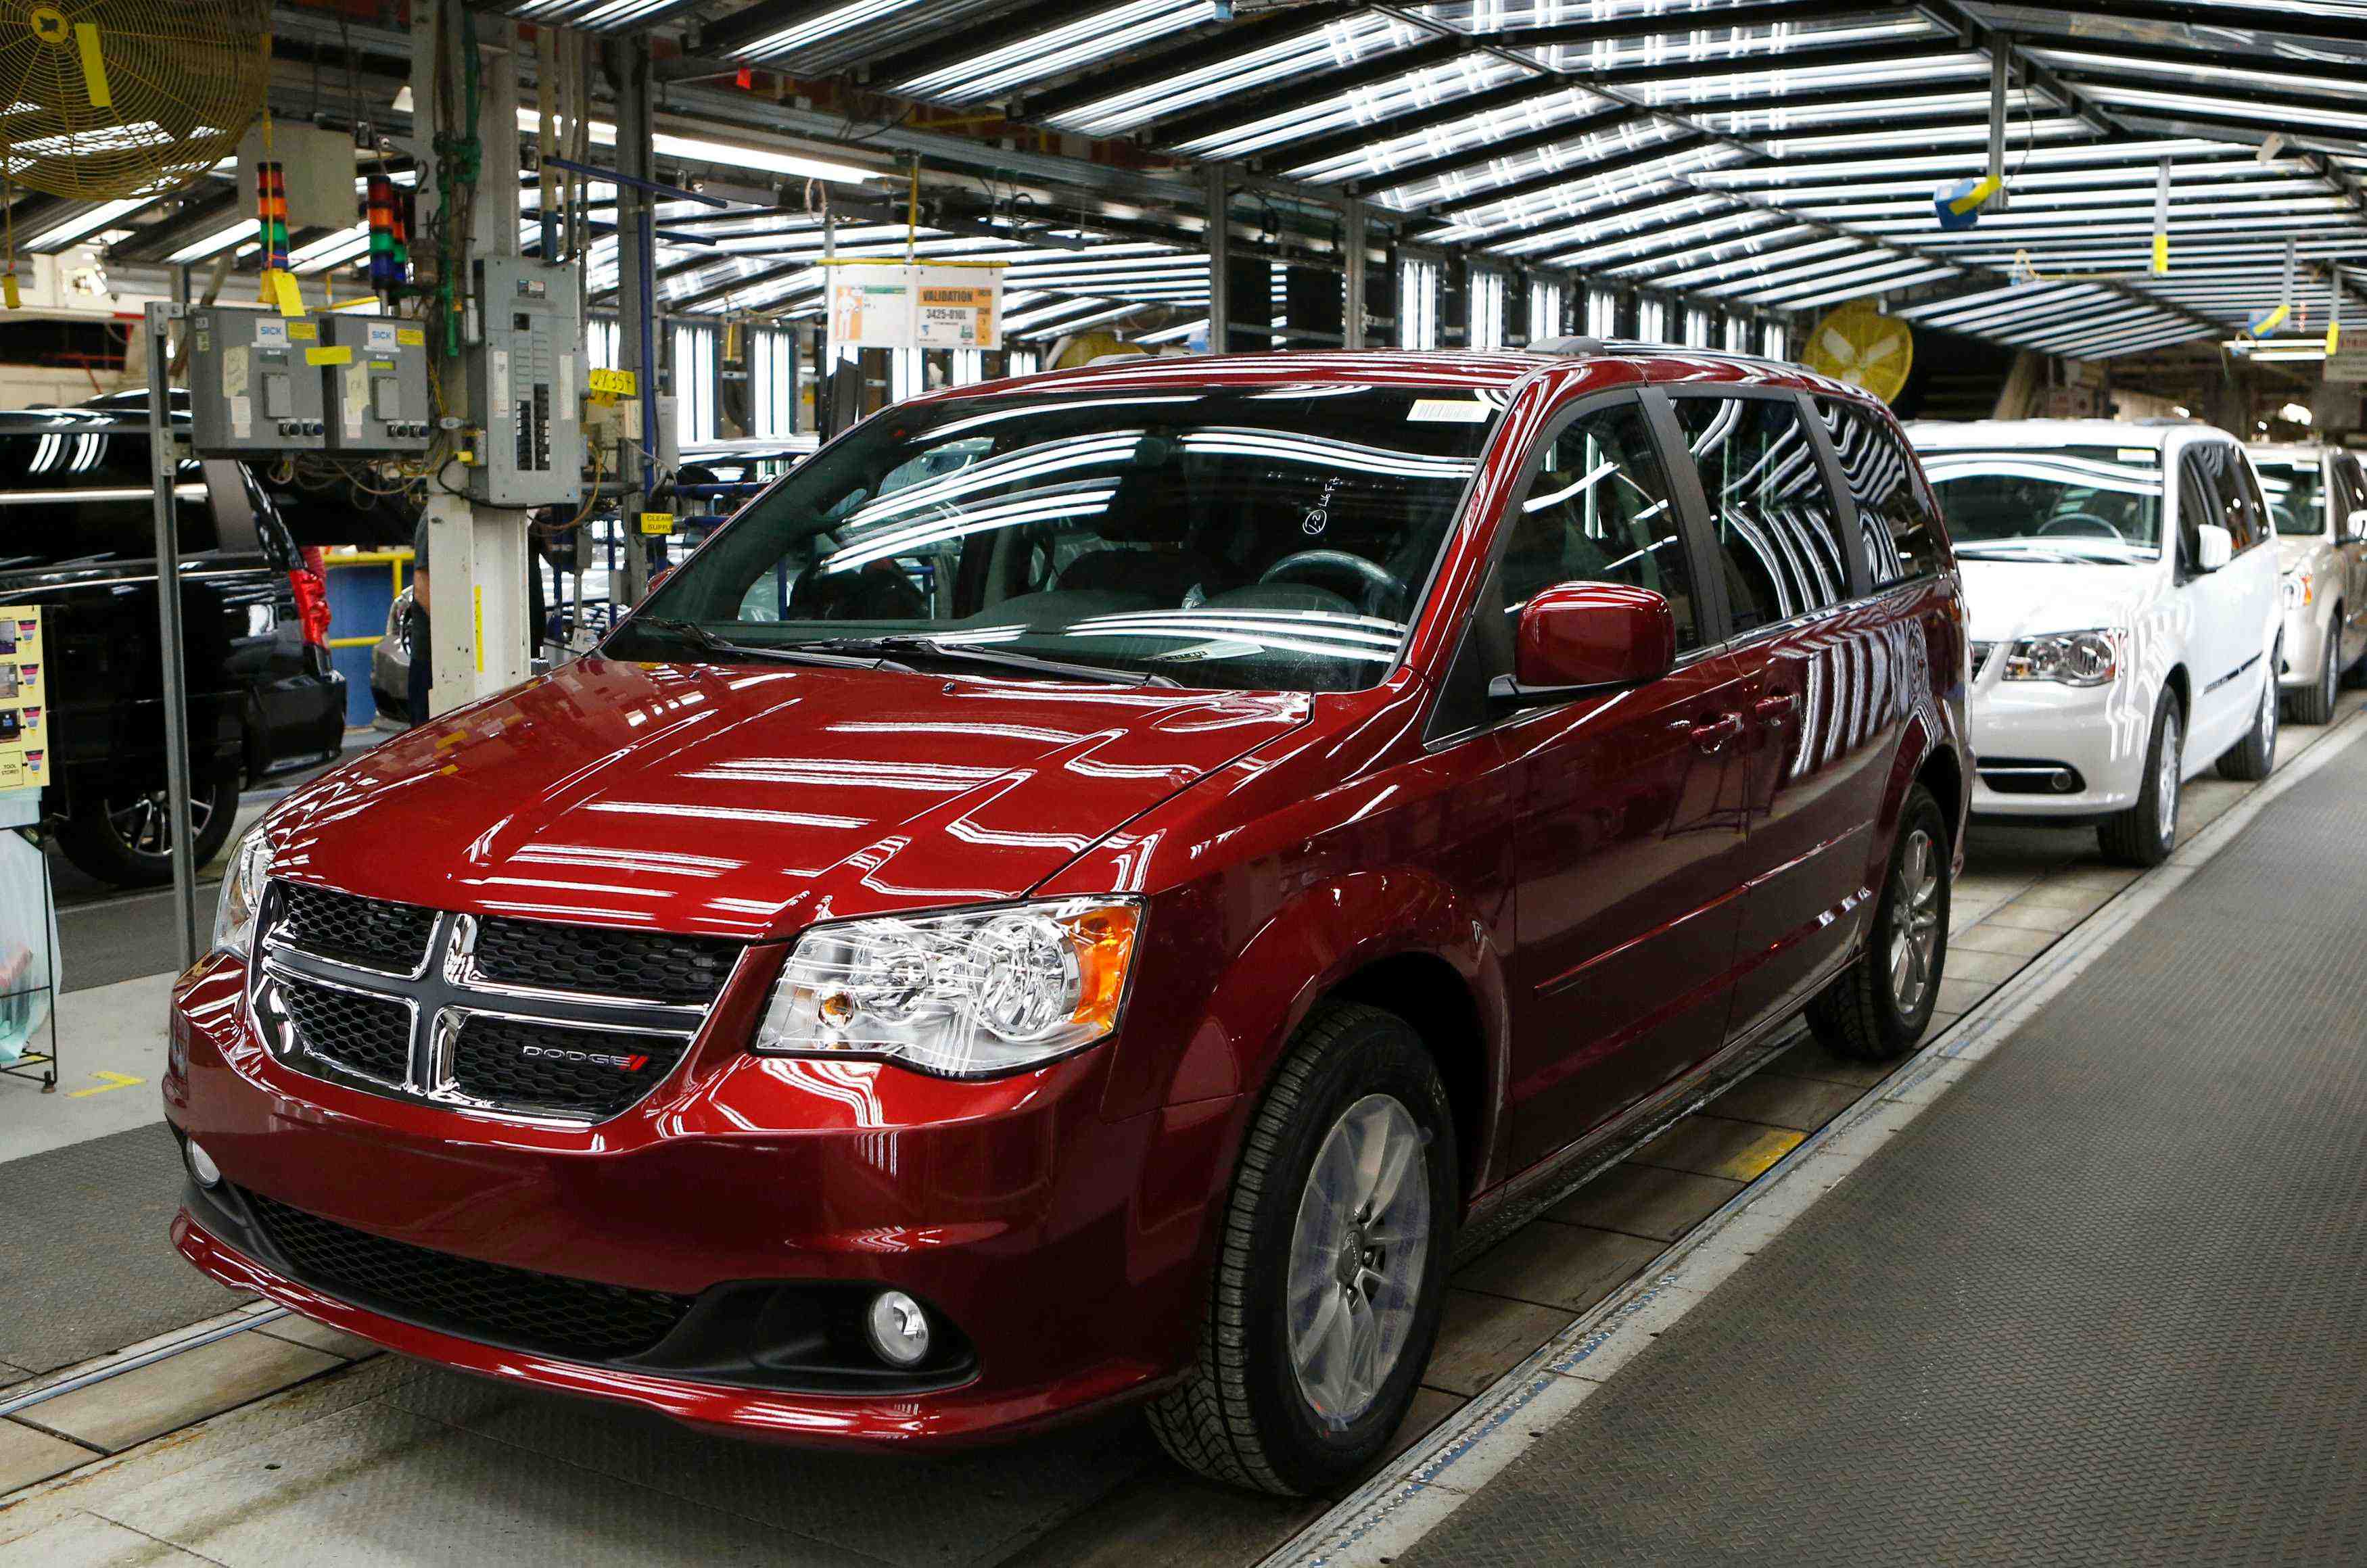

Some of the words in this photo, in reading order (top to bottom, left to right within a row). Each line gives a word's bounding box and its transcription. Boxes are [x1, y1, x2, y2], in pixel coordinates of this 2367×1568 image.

[923, 291, 972, 302] VALIDATION
[260, 326, 281, 335] SICK
[372, 331, 391, 339] SICK
[523, 1045, 631, 1067] DODGE
